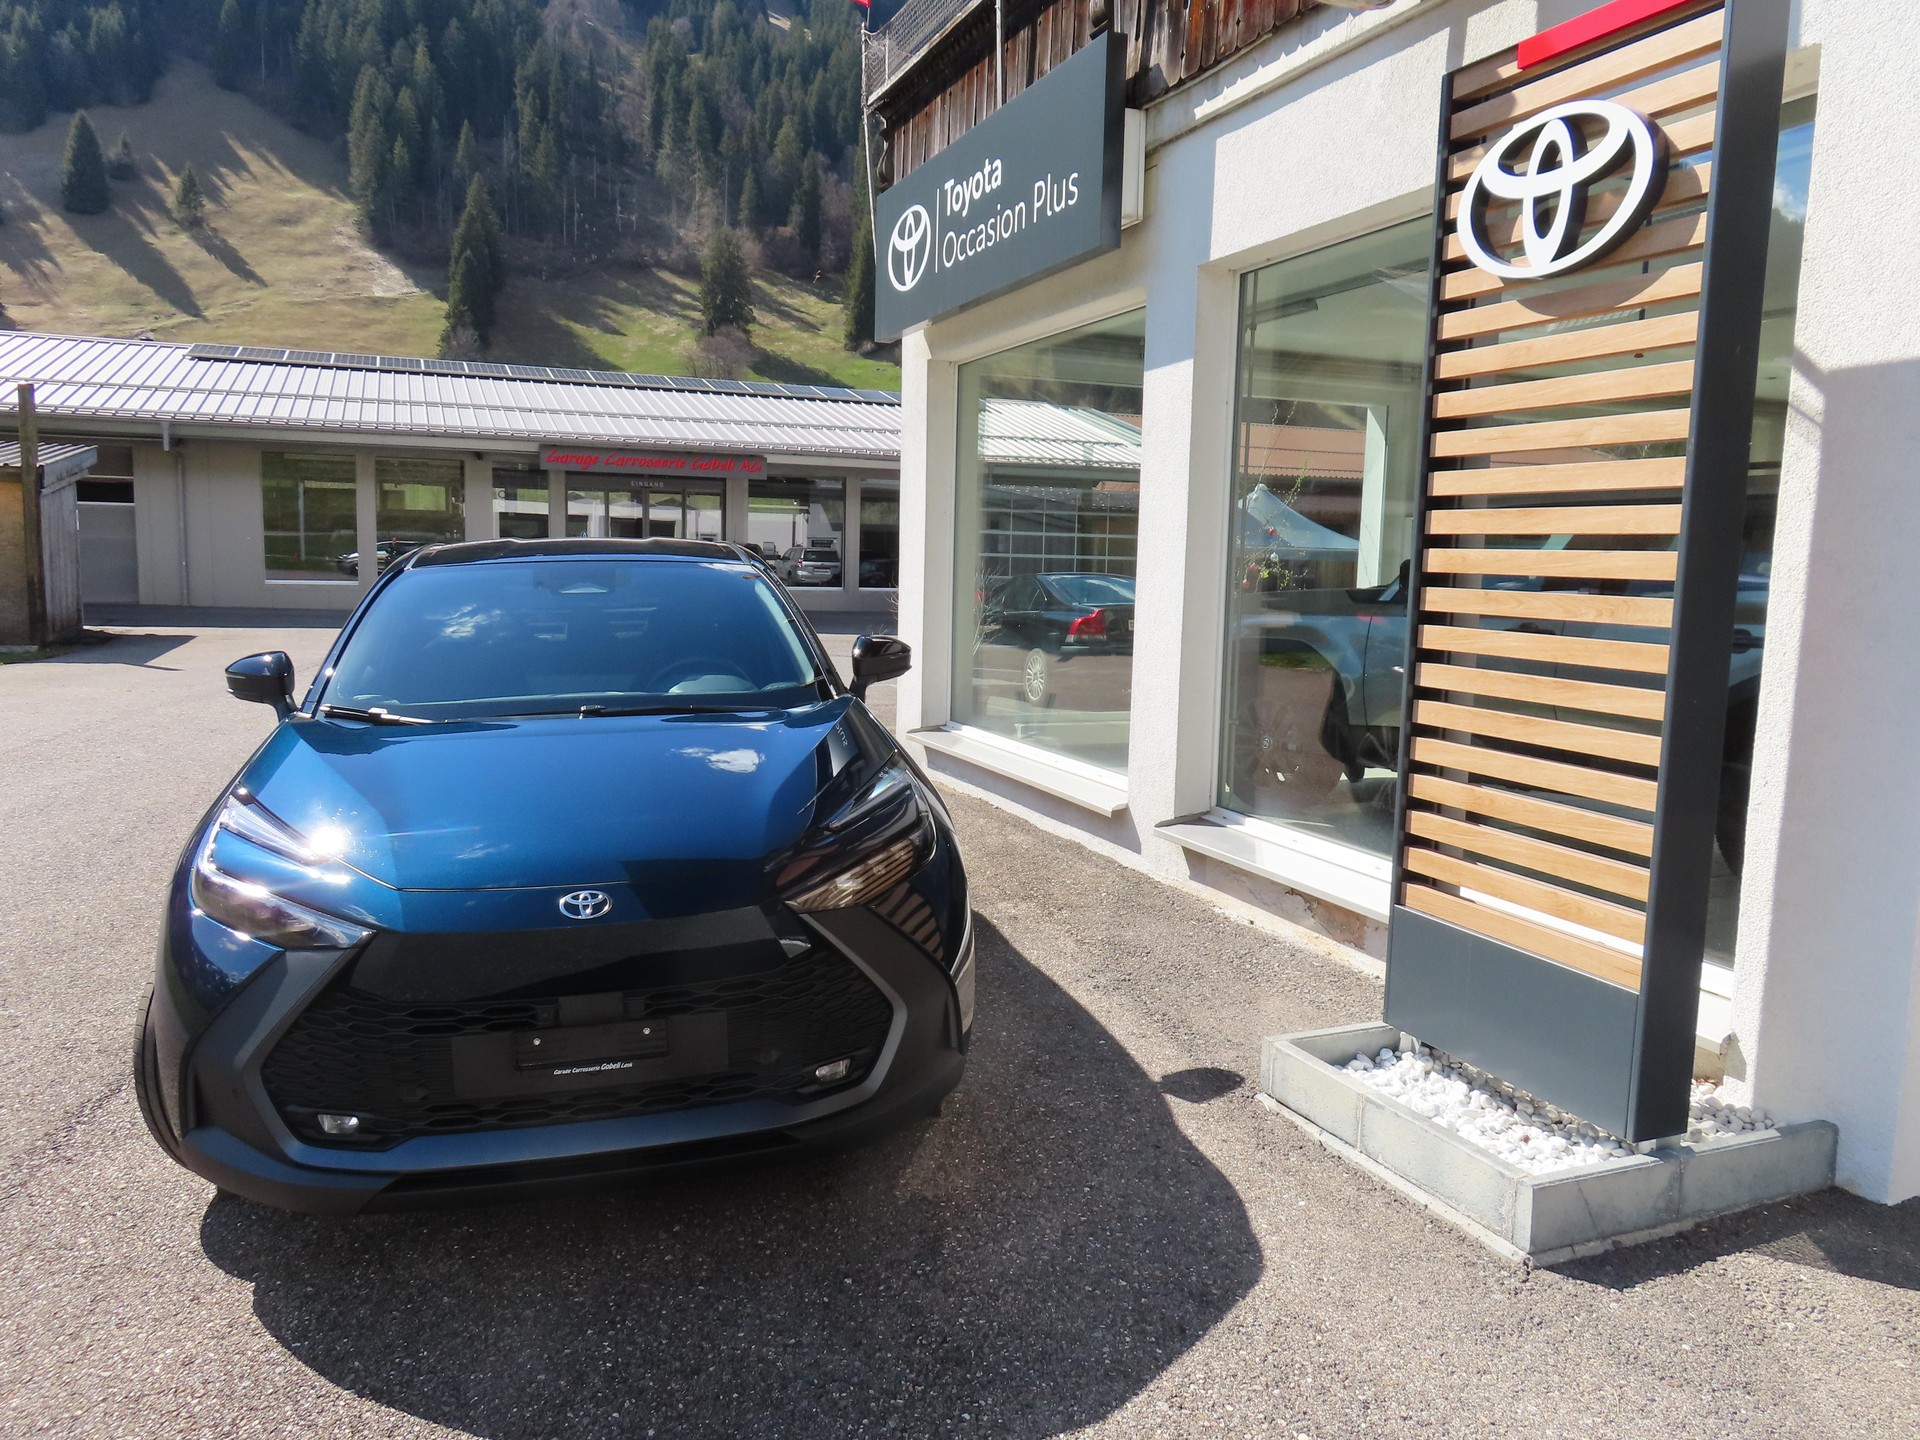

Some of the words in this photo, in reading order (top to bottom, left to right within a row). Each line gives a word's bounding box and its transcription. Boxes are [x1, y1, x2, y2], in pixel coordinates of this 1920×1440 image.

[944, 158, 1002, 218] Toyota
[943, 201, 1026, 269] Occasion
[1033, 172, 1080, 224] Plus
[546, 449, 599, 471] Garage
[604, 453, 685, 469] Carrosserie
[690, 456, 735, 472] Gobeli
[737, 457, 762, 473] AG
